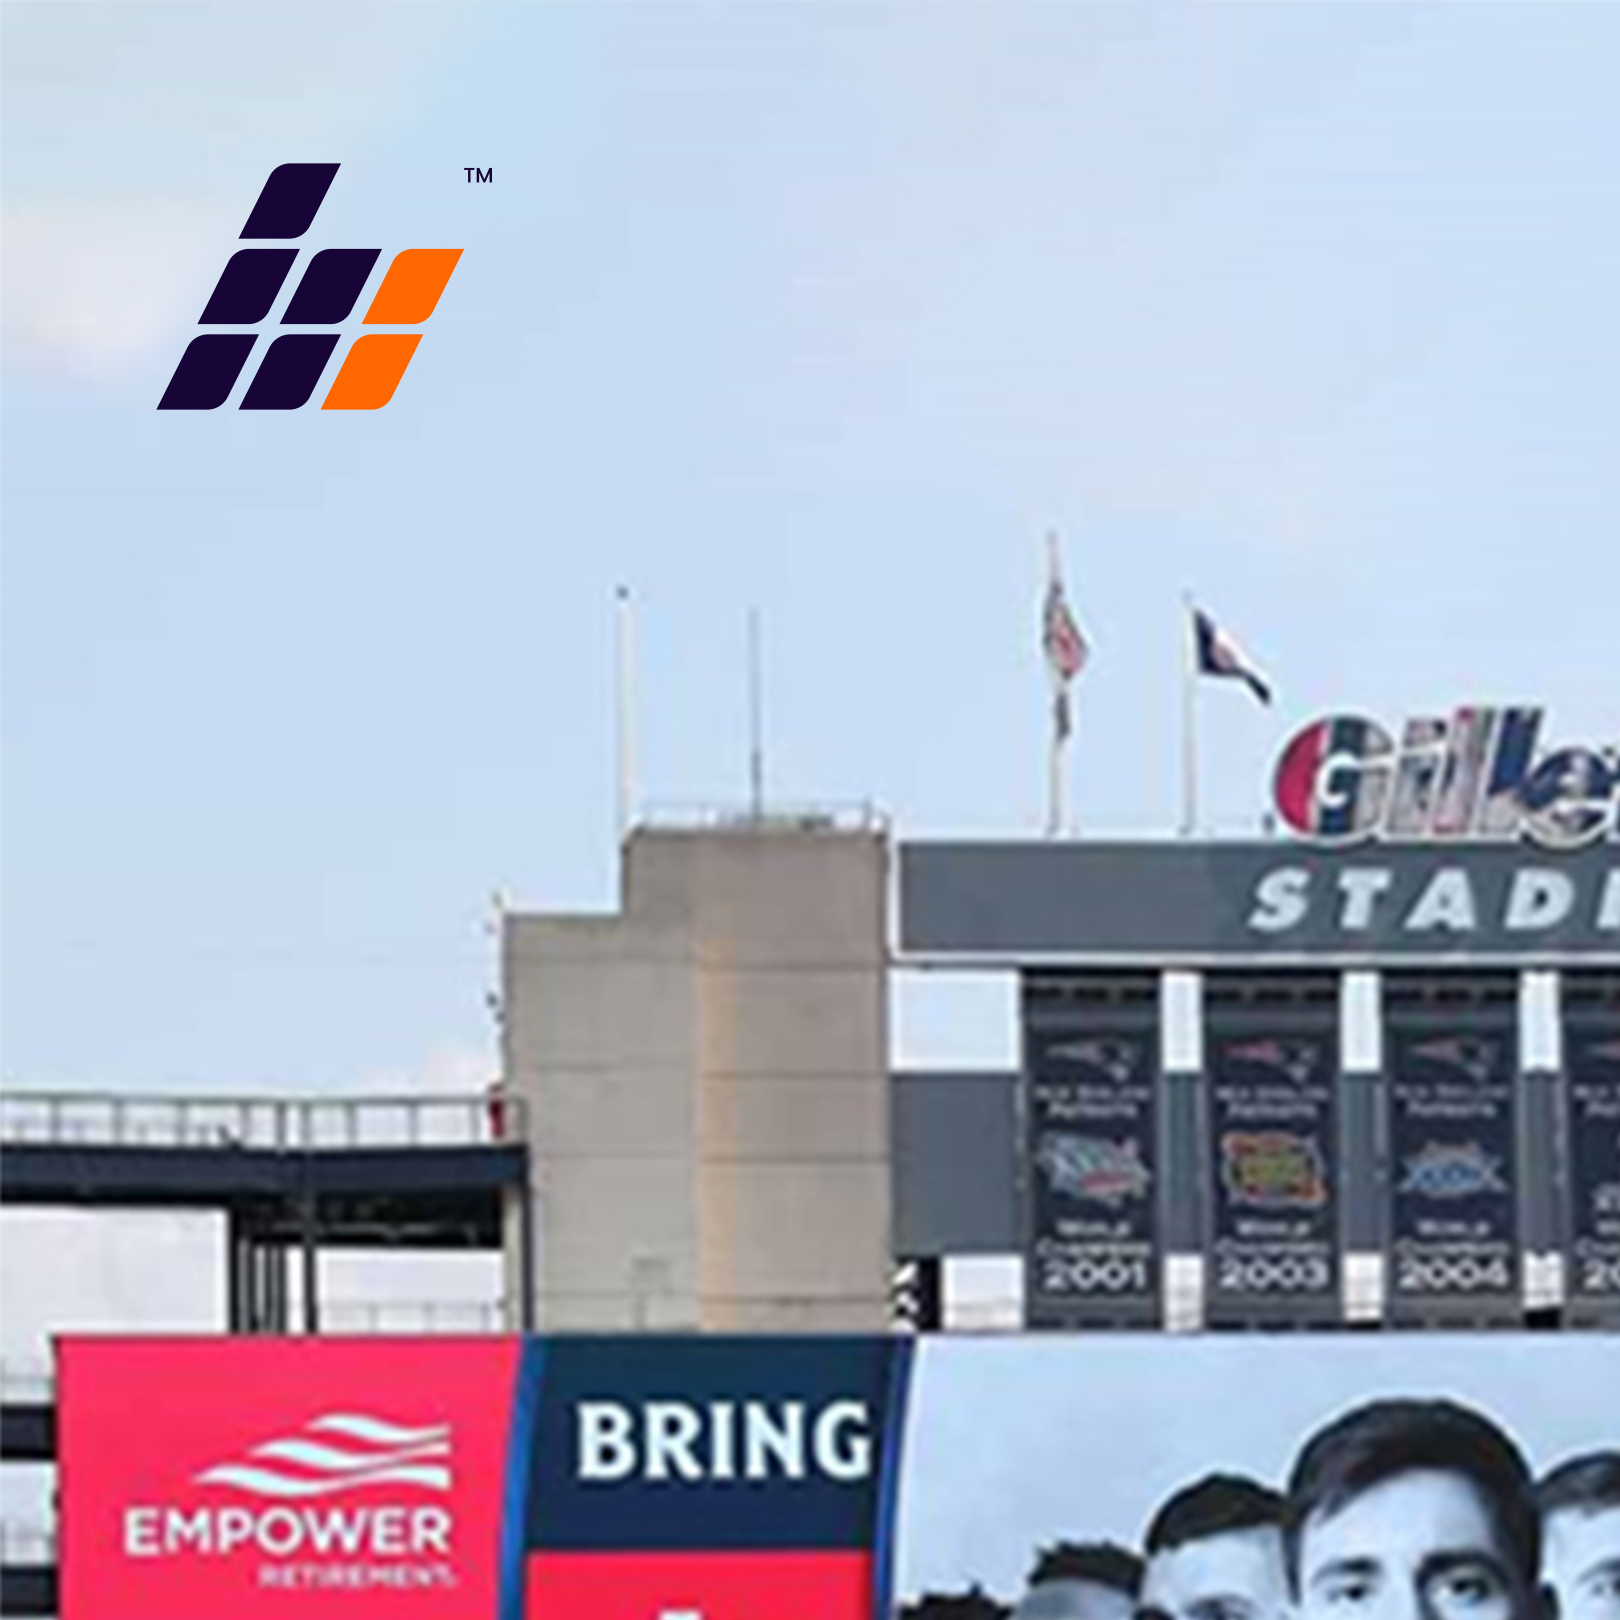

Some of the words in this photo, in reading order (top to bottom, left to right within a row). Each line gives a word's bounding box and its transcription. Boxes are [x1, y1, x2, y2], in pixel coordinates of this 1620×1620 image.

[1043, 1258, 1148, 1291] 2001
[577, 1402, 872, 1479] BRING
[122, 1507, 452, 1555] EMPOWER
